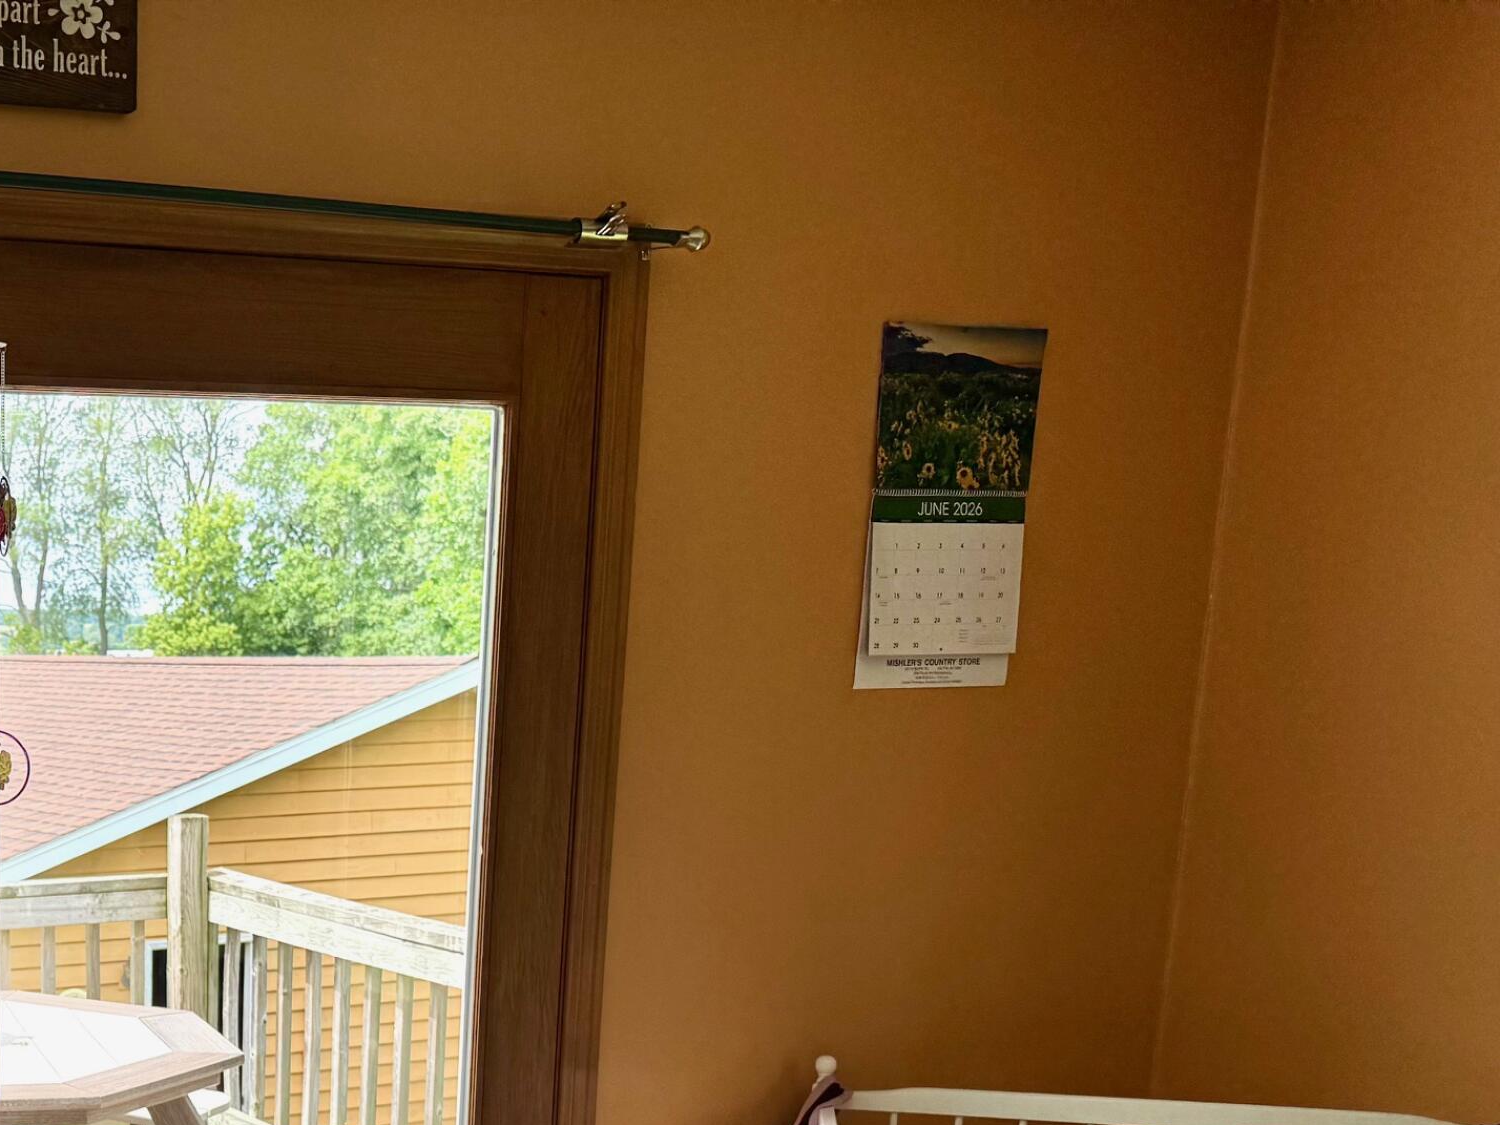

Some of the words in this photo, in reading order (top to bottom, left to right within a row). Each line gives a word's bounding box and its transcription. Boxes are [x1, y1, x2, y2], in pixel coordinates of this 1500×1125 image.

[12, 34, 45, 71] the
[52, 38, 127, 80] heart...
[917, 502, 950, 516] JUNE
[953, 502, 983, 516] 2026
[924, 658, 957, 667] COUNTRY
[958, 657, 981, 666] STORE
